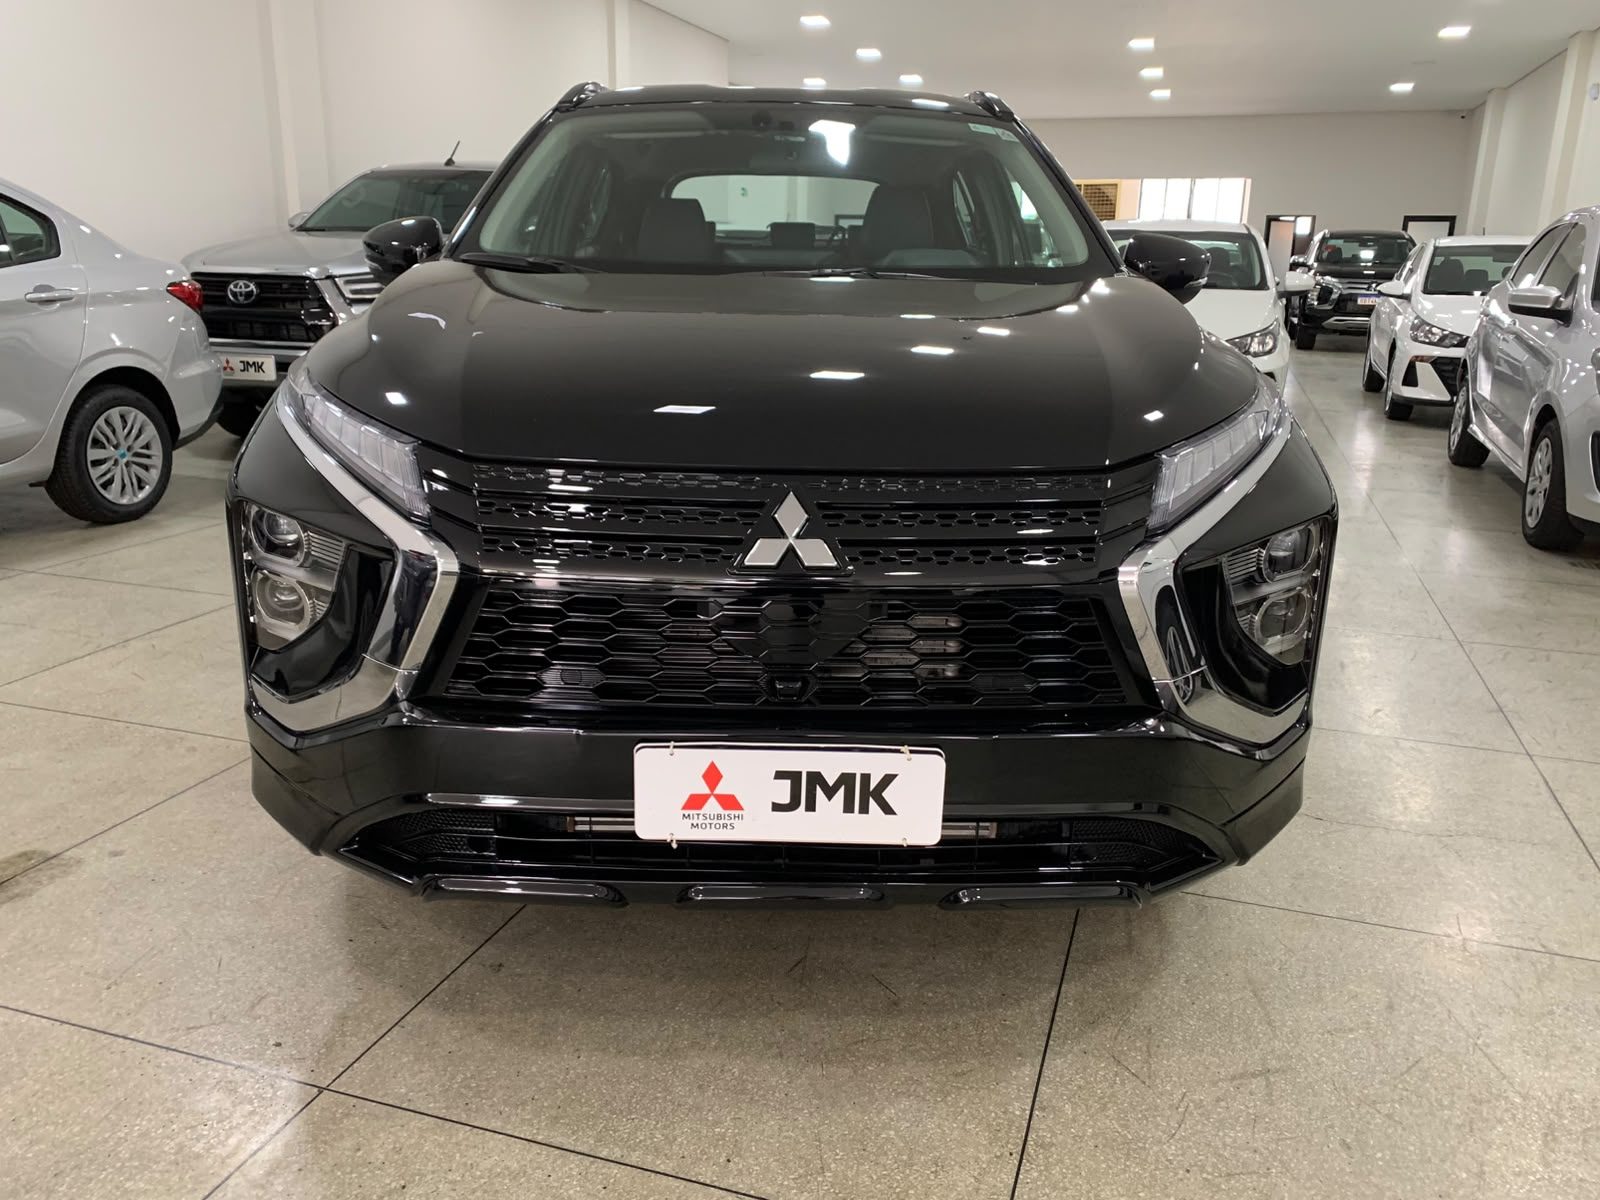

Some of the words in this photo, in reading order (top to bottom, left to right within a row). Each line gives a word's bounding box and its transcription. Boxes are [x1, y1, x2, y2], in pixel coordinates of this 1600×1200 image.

[239, 360, 265, 373] JMK
[771, 769, 899, 816] JMK
[681, 813, 744, 821] MITSUBISHI
[690, 822, 735, 830] MOTORS
